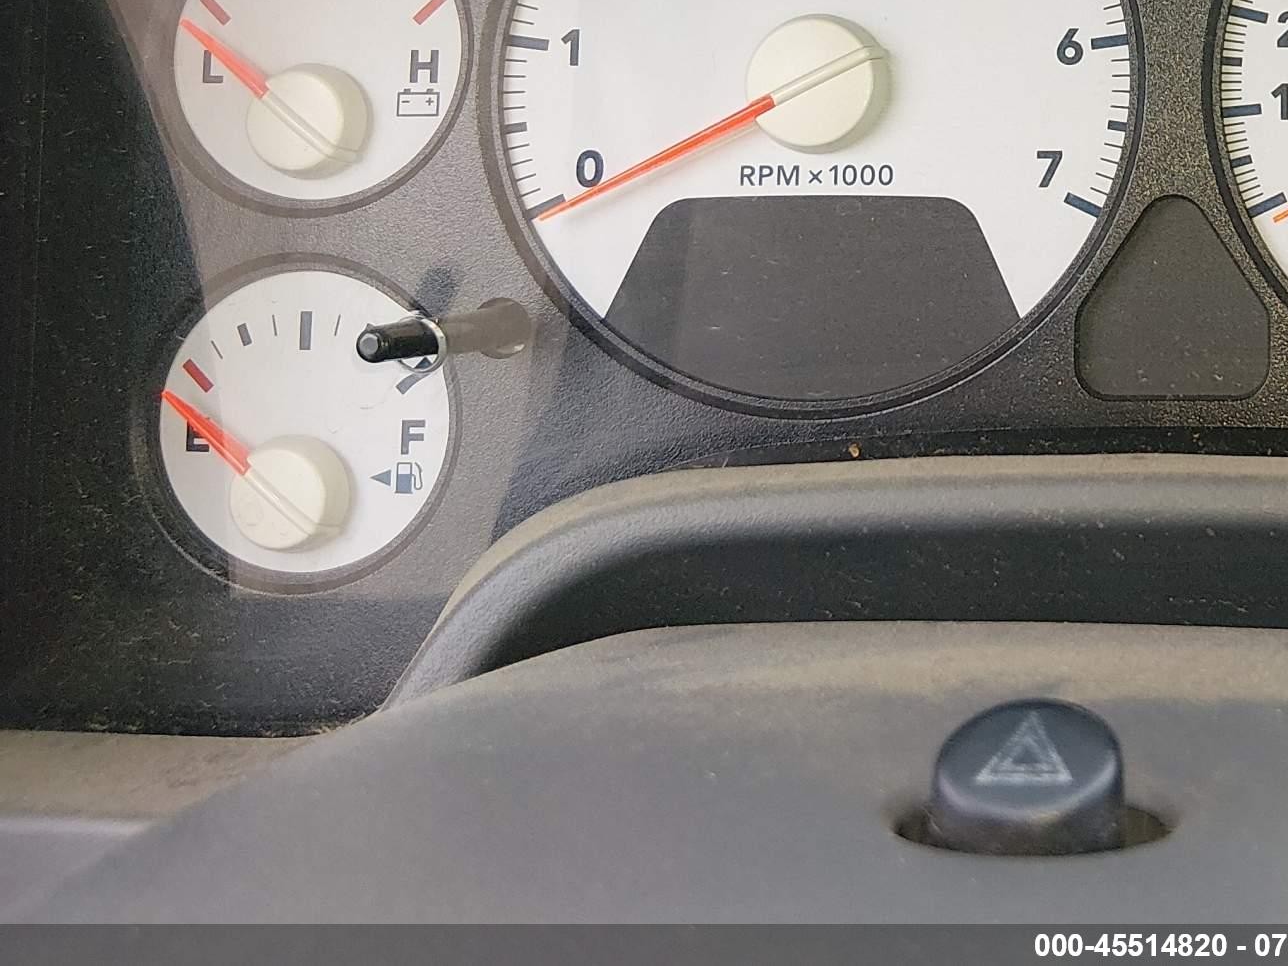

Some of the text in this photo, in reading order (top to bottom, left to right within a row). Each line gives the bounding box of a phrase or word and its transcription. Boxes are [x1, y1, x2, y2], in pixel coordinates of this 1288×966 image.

[561, 29, 579, 66] 1
[1057, 28, 1083, 65] 6
[203, 50, 223, 83] L
[410, 50, 439, 83] H
[576, 150, 603, 188] 0
[741, 166, 799, 186] RPM
[1037, 151, 1062, 187] 7
[401, 420, 425, 455] F
